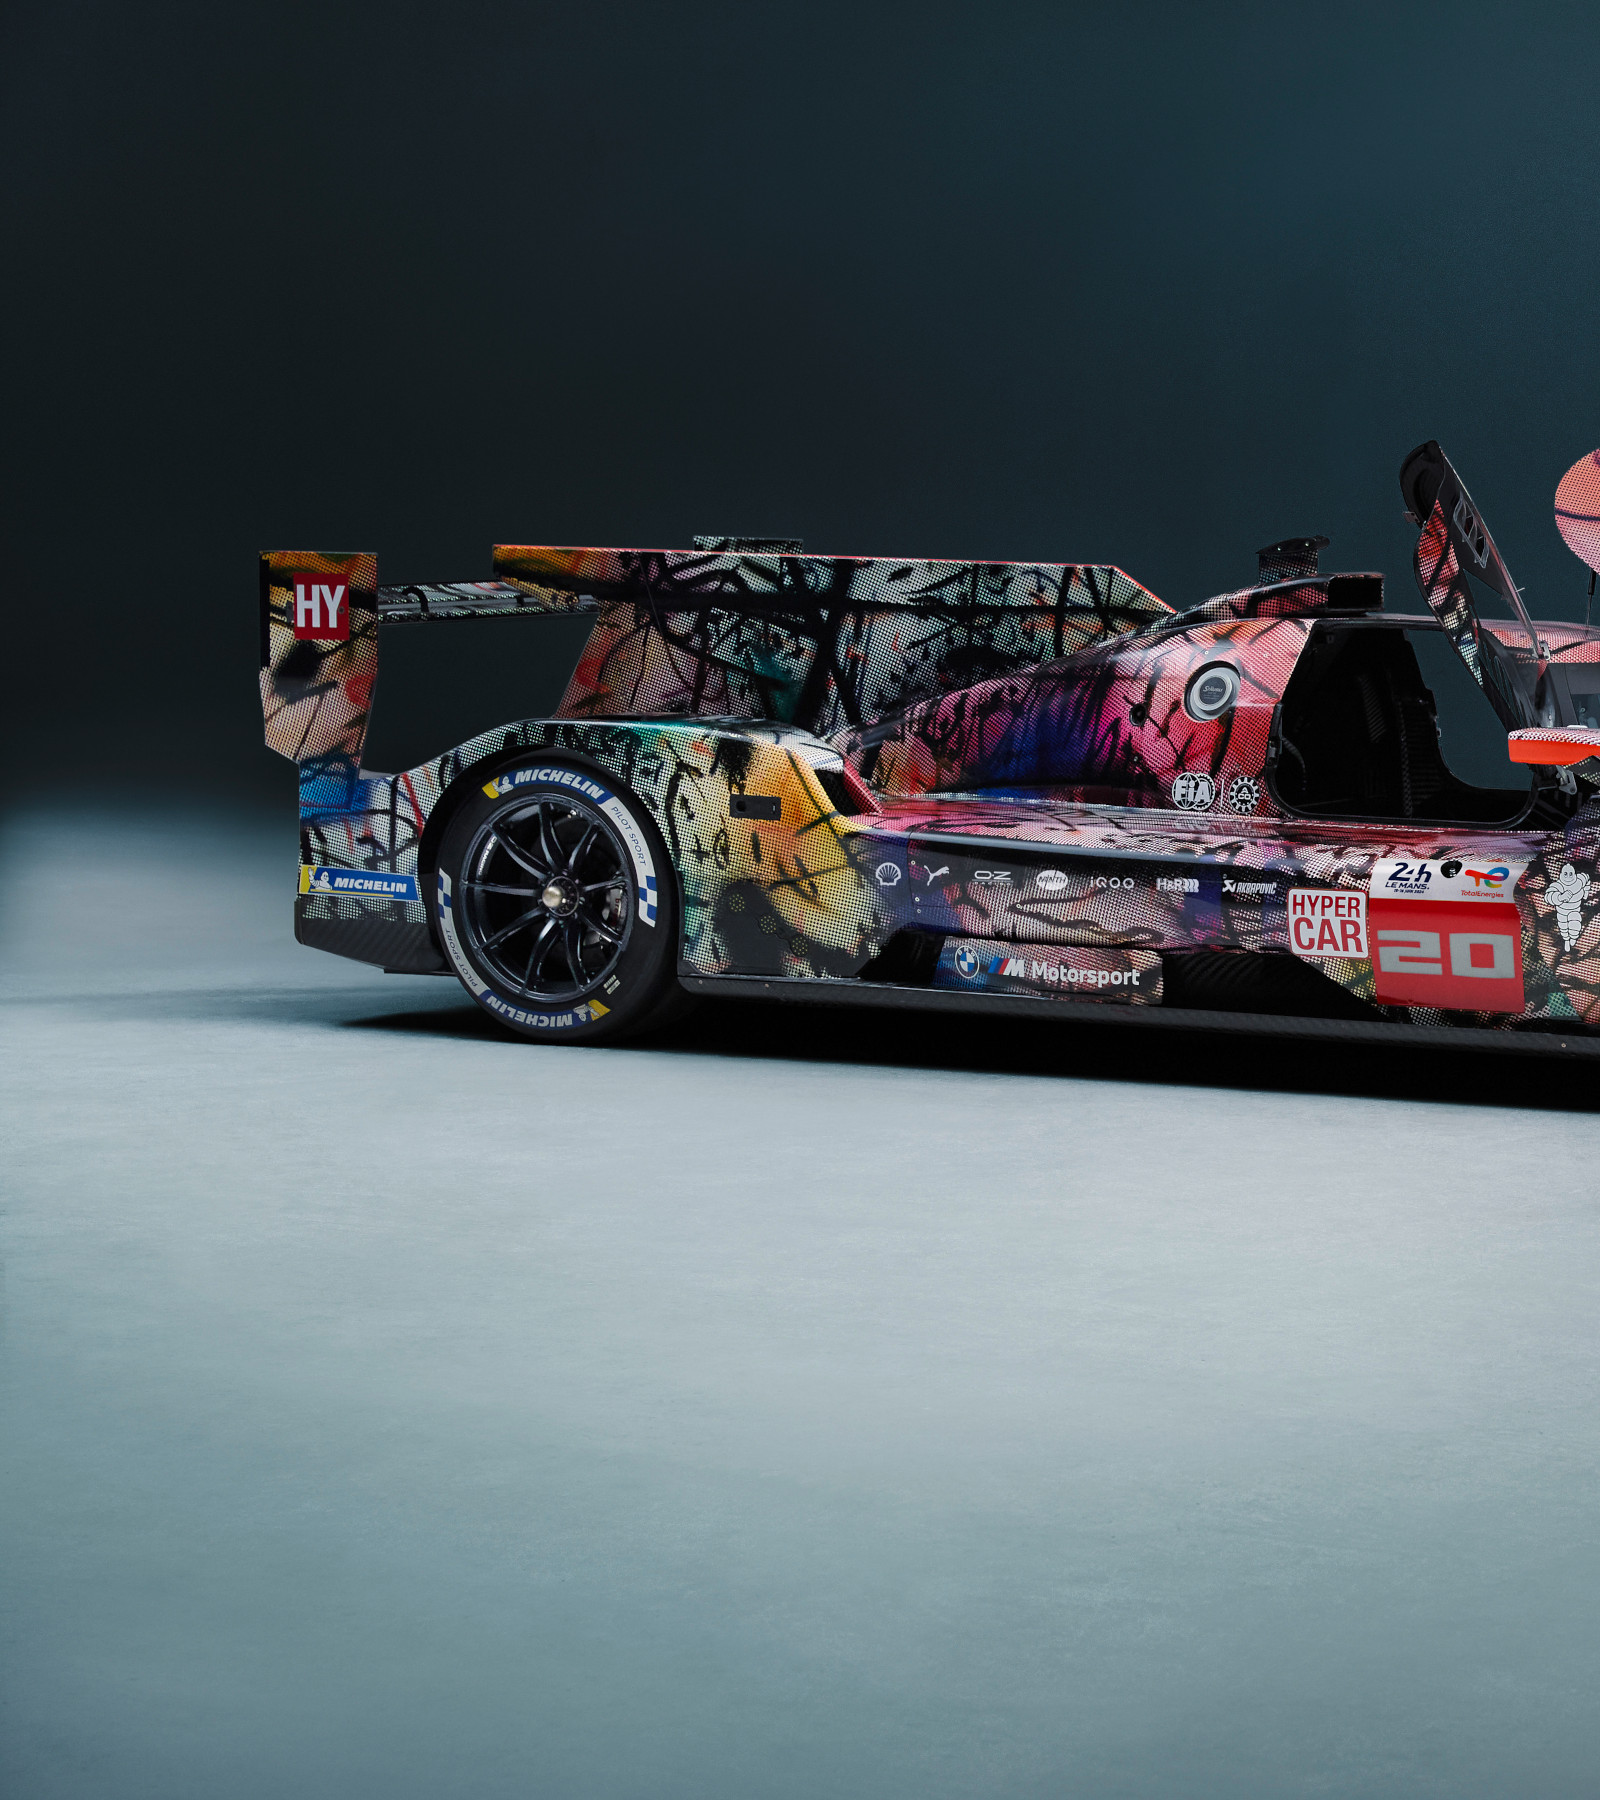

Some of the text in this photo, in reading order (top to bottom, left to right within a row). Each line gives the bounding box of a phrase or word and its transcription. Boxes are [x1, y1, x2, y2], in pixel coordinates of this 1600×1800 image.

[296, 584, 346, 628] HY
[514, 768, 605, 800] MICHELIN
[611, 806, 647, 866] PILOT SPORT
[334, 877, 407, 893] MICHELIN
[1461, 889, 1504, 899] TotalEnergies
[1292, 894, 1361, 918] HYPER
[1293, 917, 1364, 953] CAR
[446, 929, 478, 987] PILOT SPORT
[1377, 929, 1516, 979] 20
[1032, 960, 1140, 988] Motorsport
[486, 995, 573, 1027] MICHELIN
